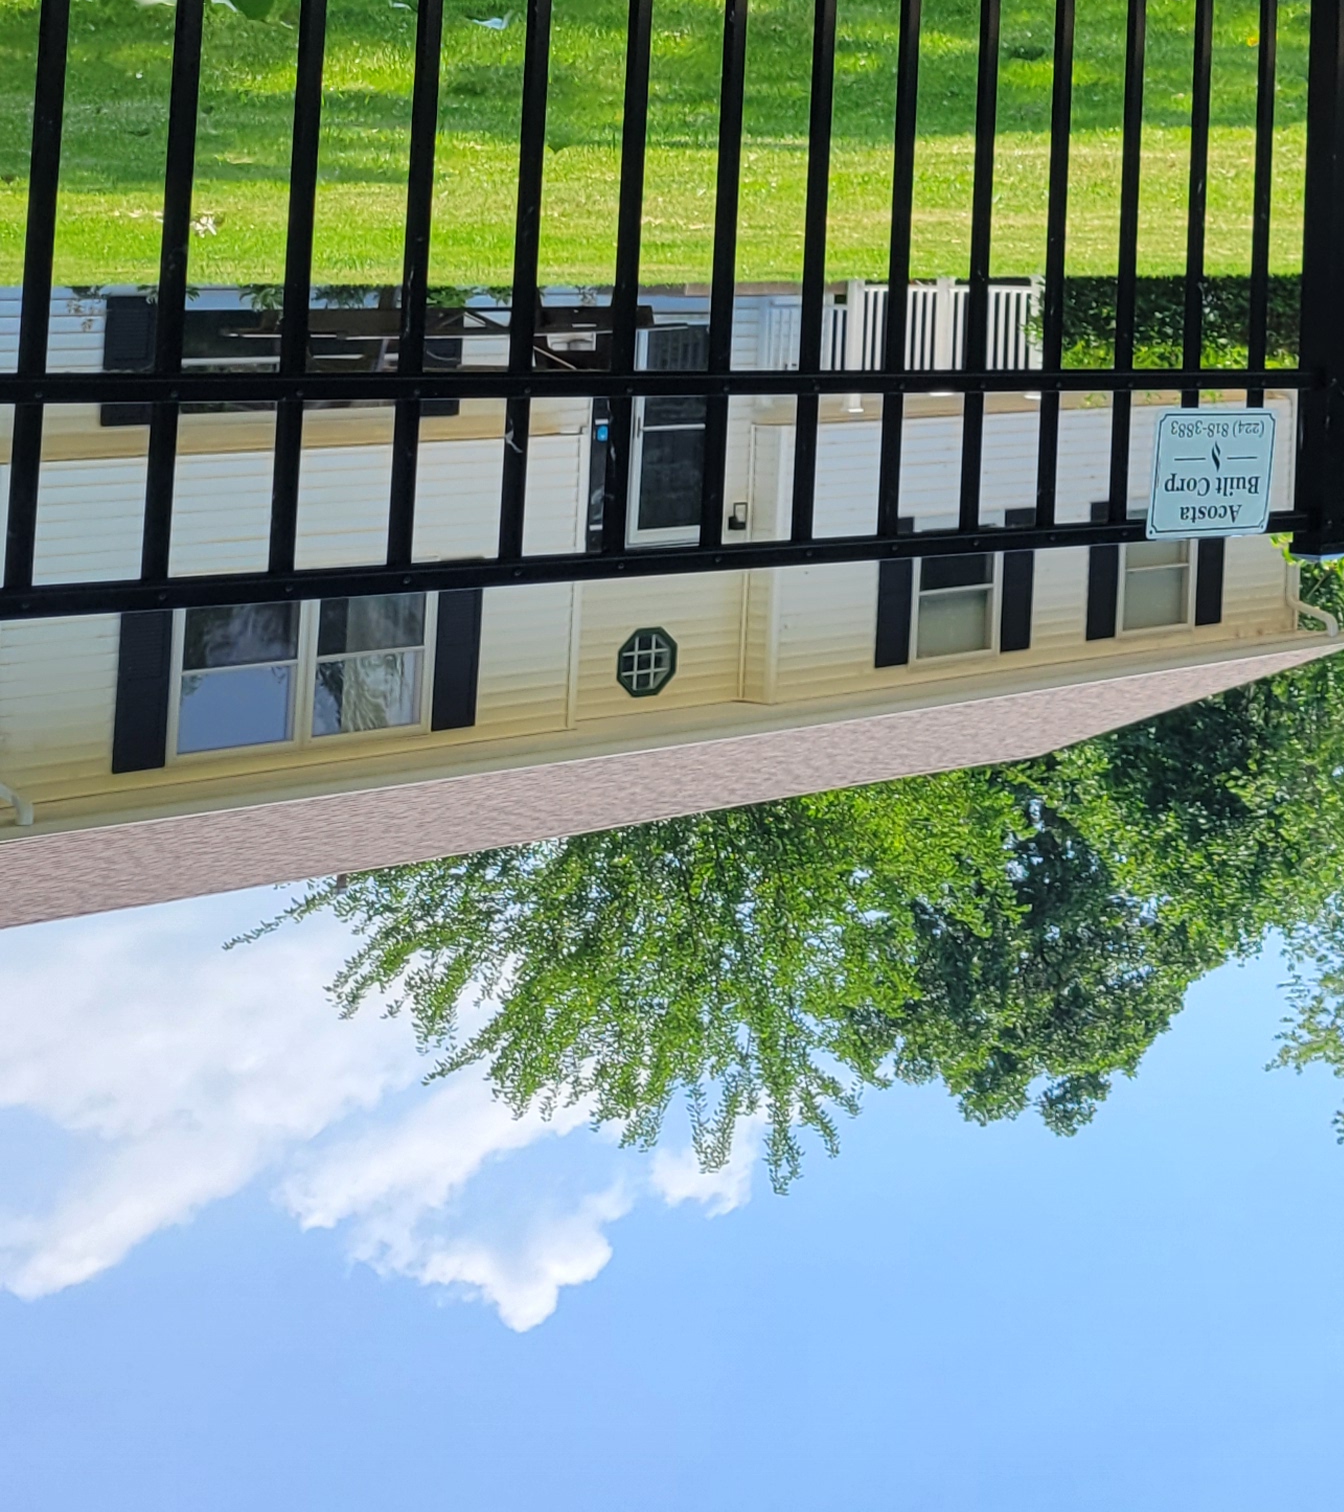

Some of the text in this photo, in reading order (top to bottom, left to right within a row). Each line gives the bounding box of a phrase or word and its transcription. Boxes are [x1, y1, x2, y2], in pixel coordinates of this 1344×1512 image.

[1171, 420, 1265, 438] (224) 818-3883
[1164, 474, 1261, 496] Built Corp
[1180, 504, 1242, 524] Acosta
